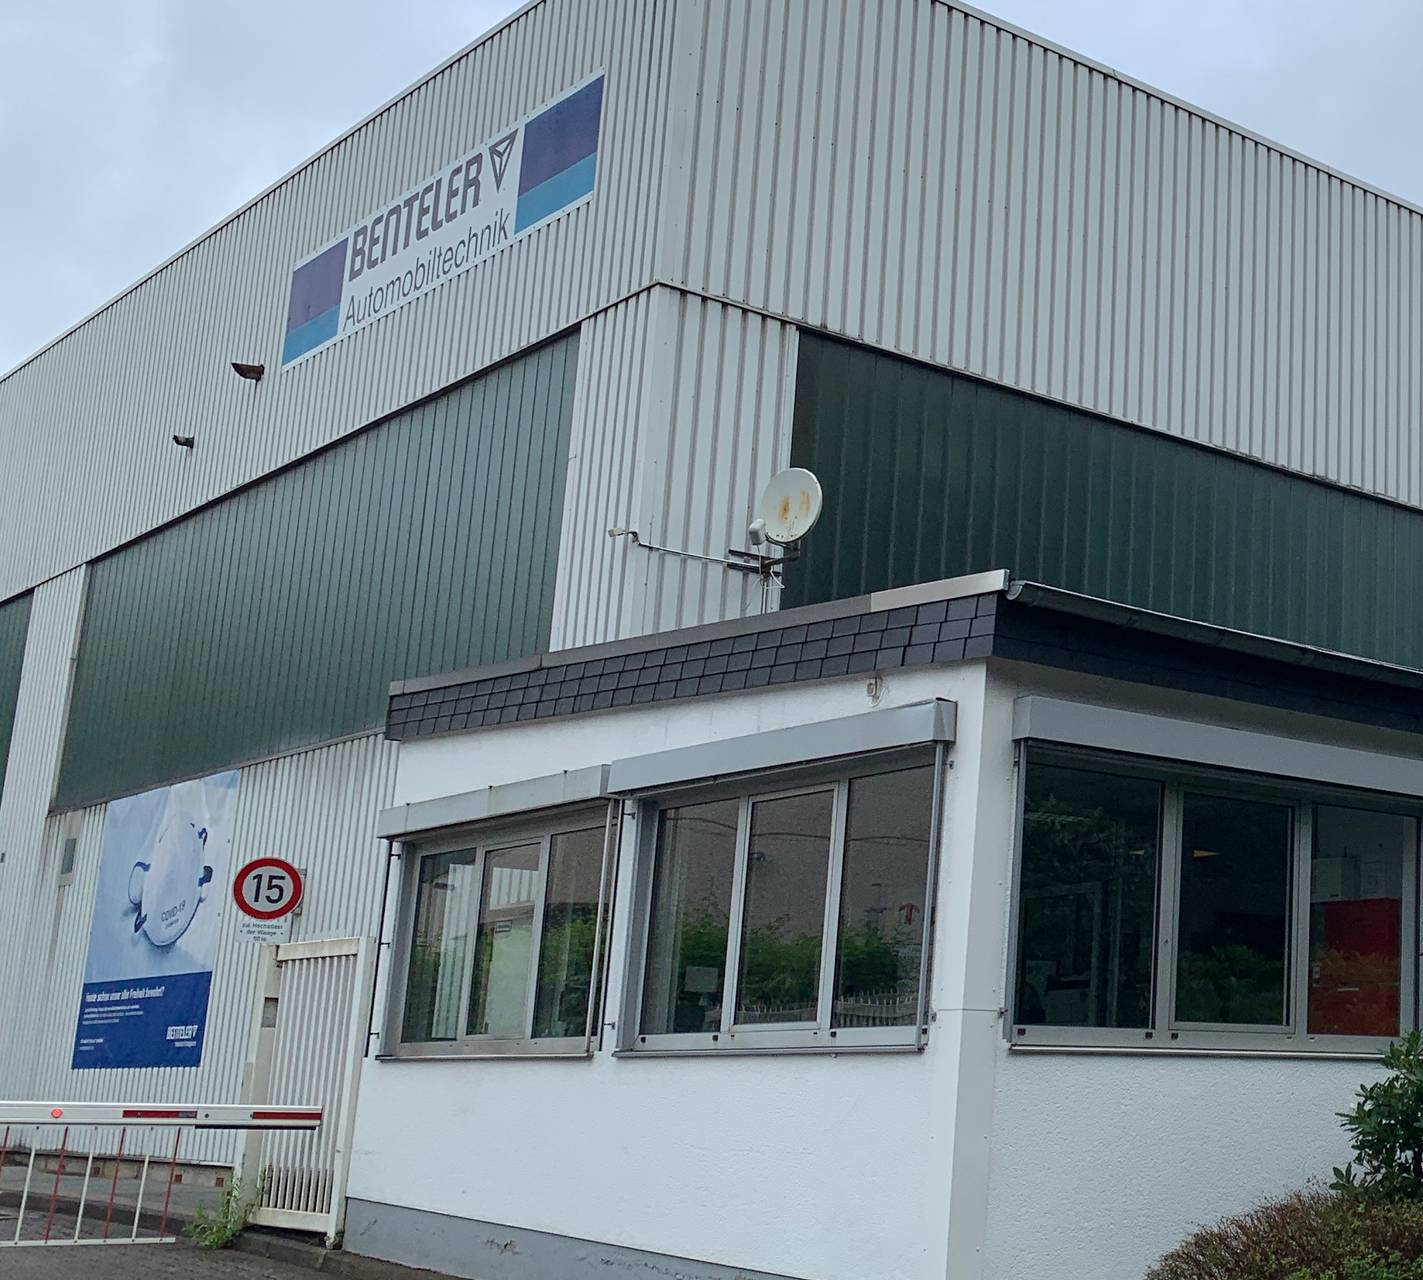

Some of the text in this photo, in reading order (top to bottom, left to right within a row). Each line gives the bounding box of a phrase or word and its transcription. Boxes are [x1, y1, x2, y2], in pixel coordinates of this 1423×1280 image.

[342, 207, 511, 332] Automobiltechnik
[348, 152, 484, 283] BENTELER
[252, 873, 286, 904] 15
